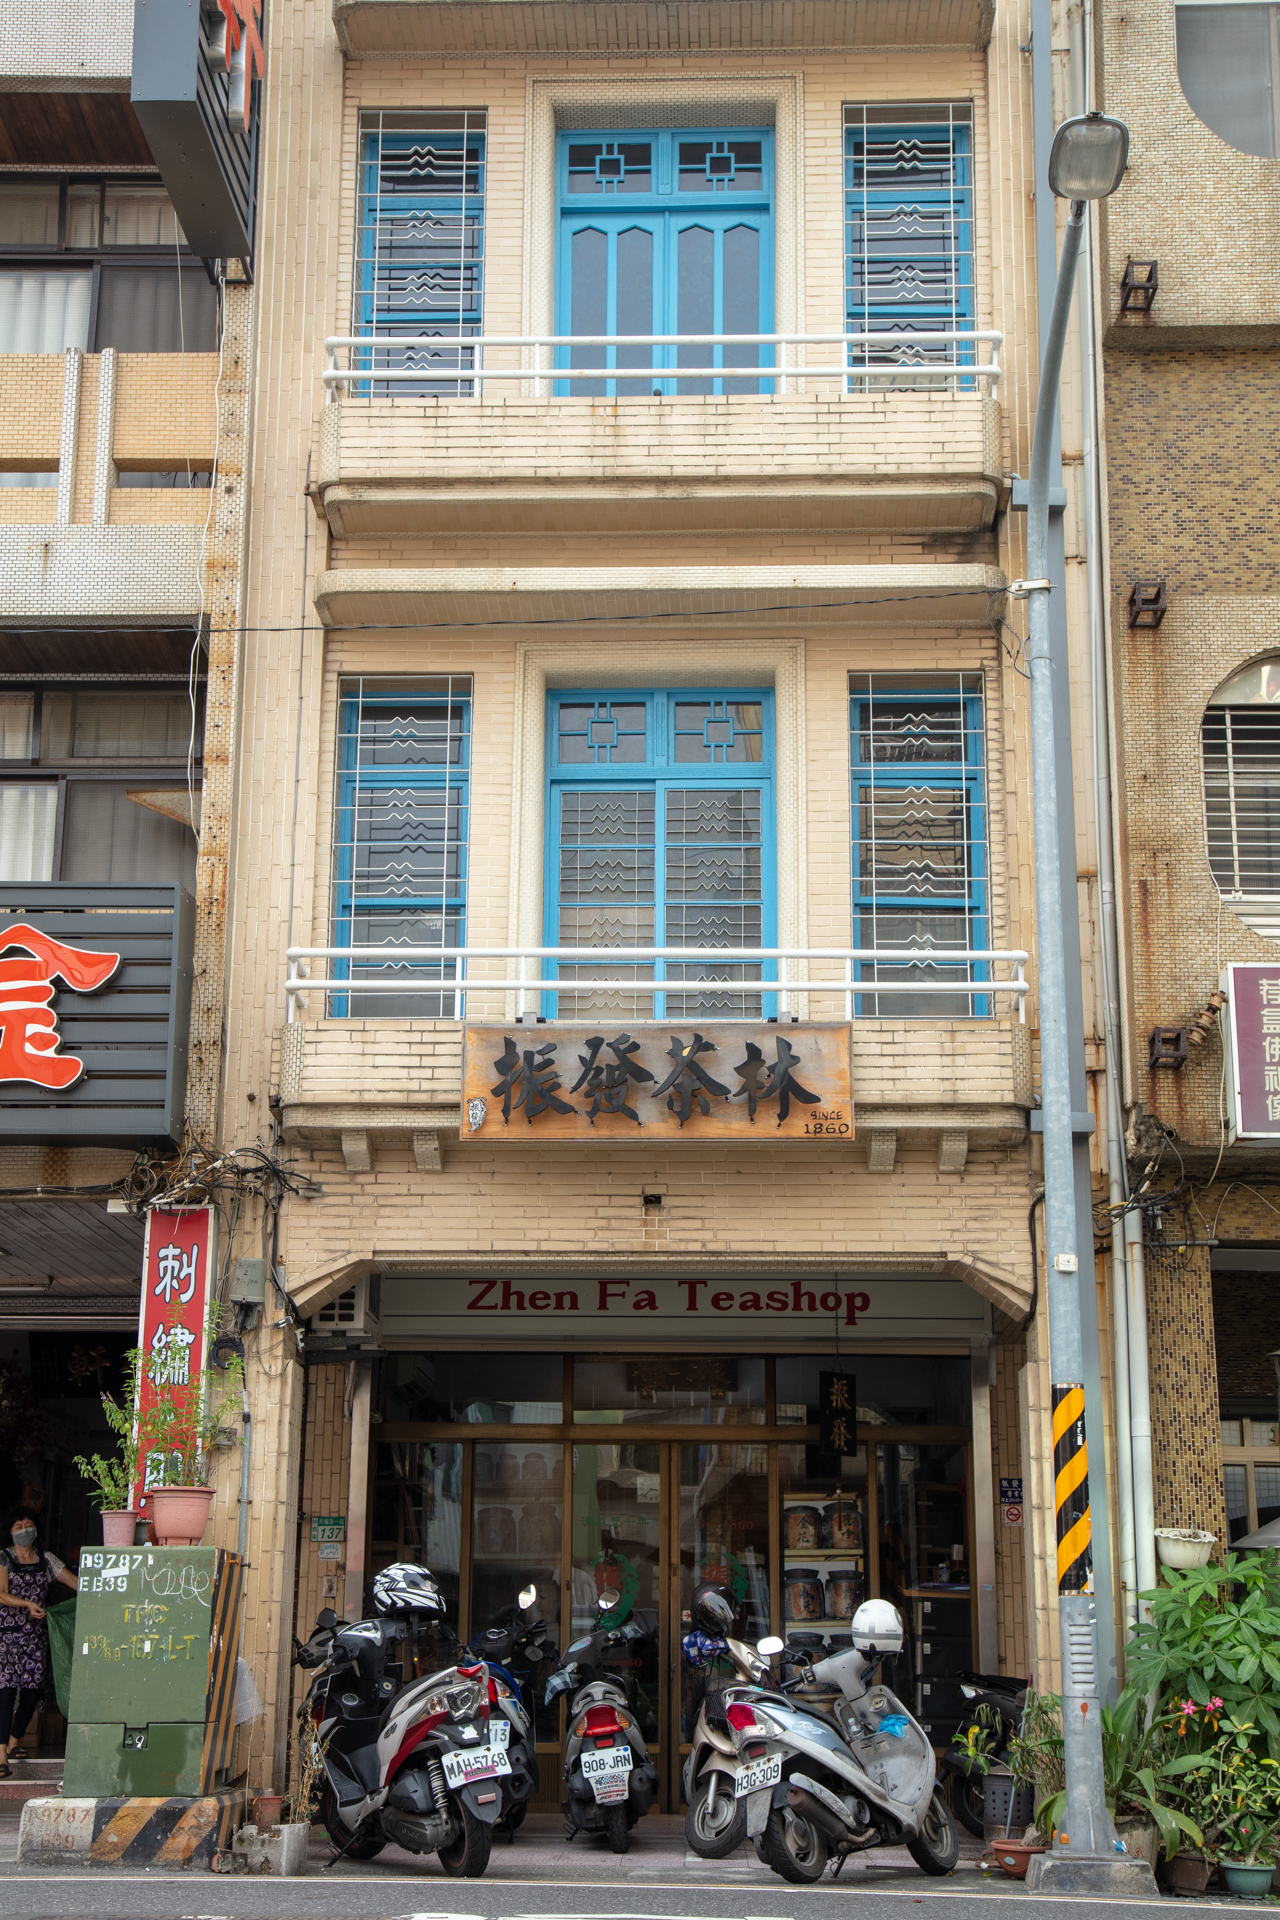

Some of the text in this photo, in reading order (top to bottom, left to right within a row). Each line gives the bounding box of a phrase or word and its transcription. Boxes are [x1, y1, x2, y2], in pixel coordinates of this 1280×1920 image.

[810, 1110, 843, 1121] SINCE
[804, 1122, 849, 1136] 1860
[467, 1279, 871, 1326] Zhen Fa Teashop
[723, 1519, 754, 1530] 1860
[320, 1527, 342, 1539] 137
[79, 1576, 128, 1592] EB39
